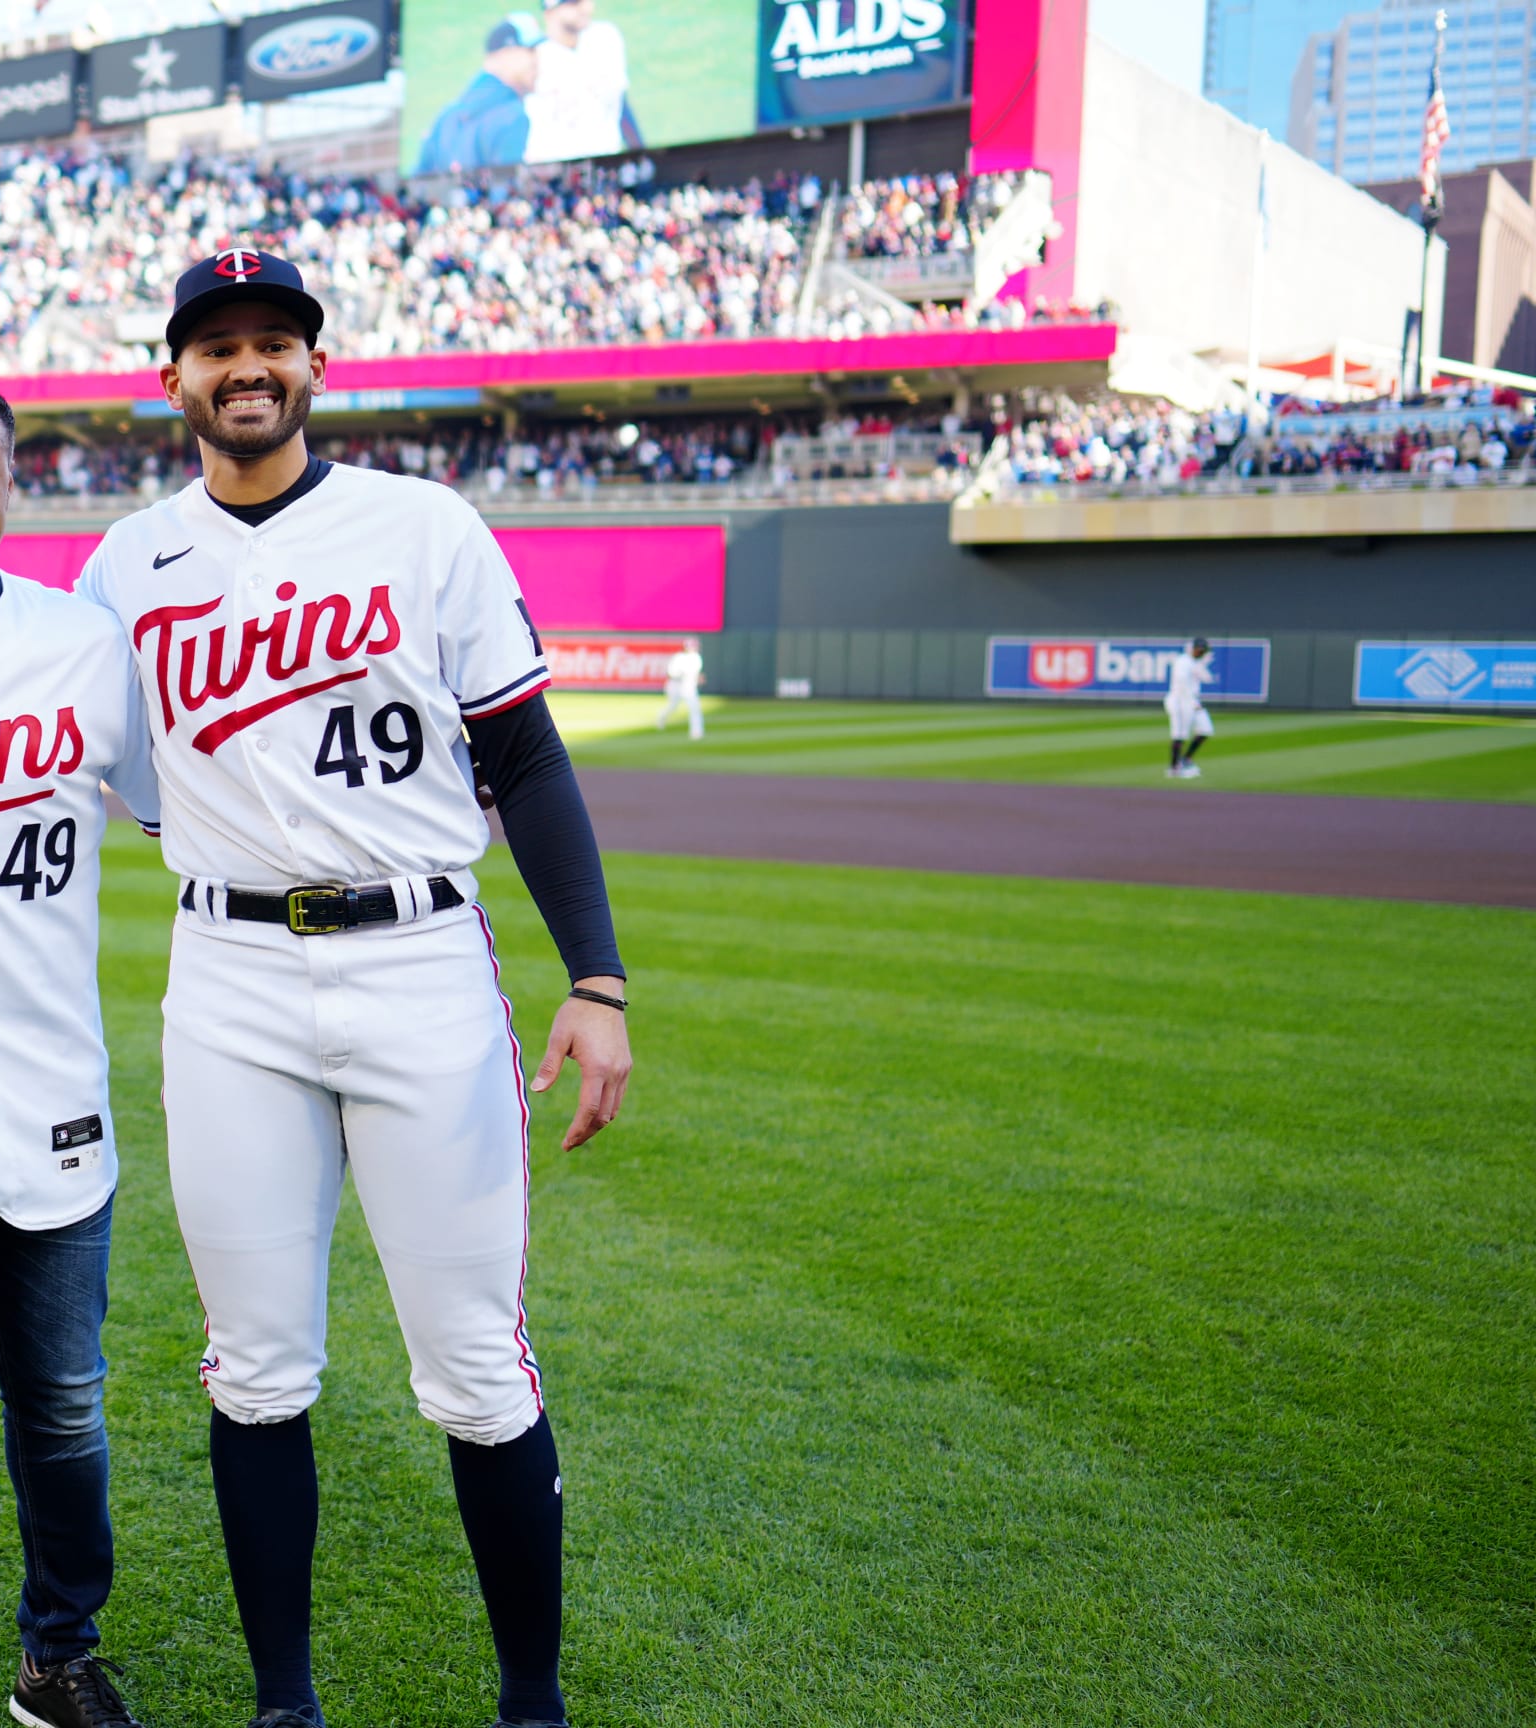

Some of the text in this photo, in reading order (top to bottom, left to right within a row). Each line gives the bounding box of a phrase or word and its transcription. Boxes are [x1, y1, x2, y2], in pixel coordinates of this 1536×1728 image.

[269, 32, 352, 70] Ford
[770, 0, 946, 60] ALDS
[133, 581, 400, 736] Twins
[1036, 649, 1088, 683] us
[315, 701, 423, 788] 49
